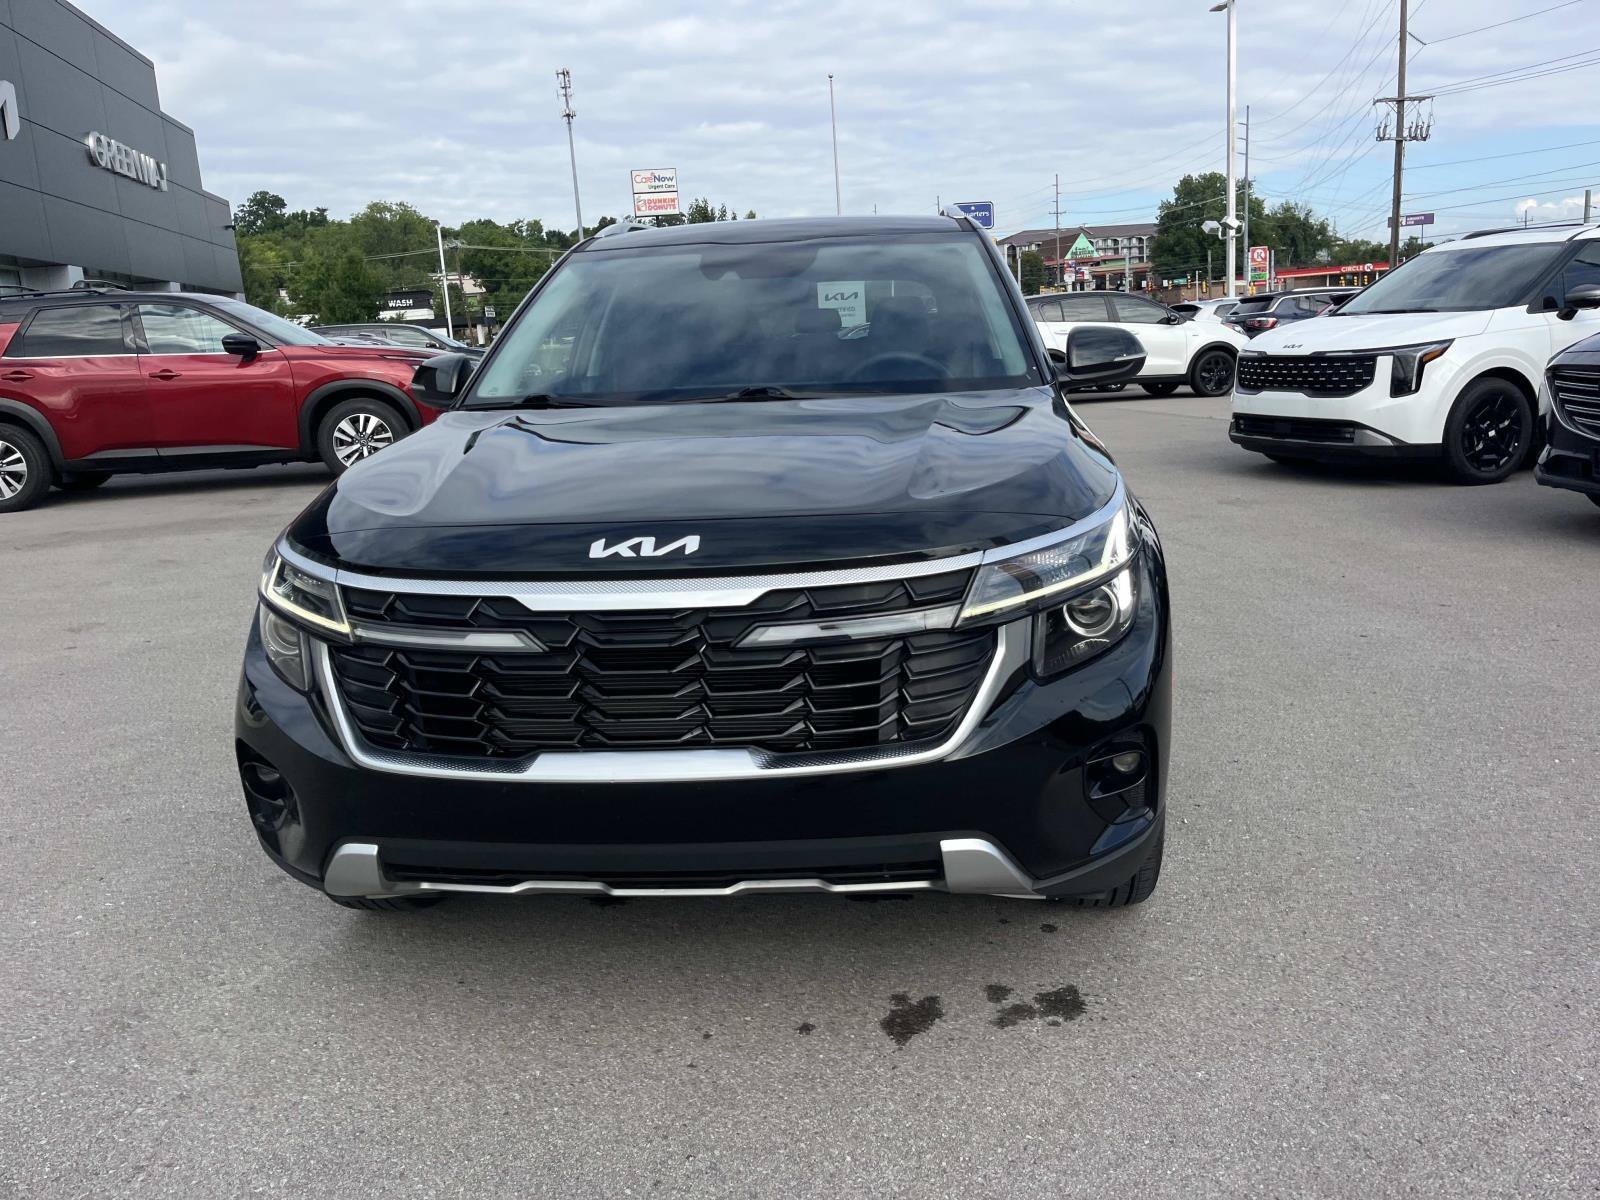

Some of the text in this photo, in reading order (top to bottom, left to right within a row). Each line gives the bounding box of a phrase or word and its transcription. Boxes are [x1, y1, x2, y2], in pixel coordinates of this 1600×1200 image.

[88, 131, 168, 192] GREENWAY
[634, 174, 674, 183] CareNow
[1341, 265, 1364, 273] CIRCLE
[388, 299, 413, 308] WASH
